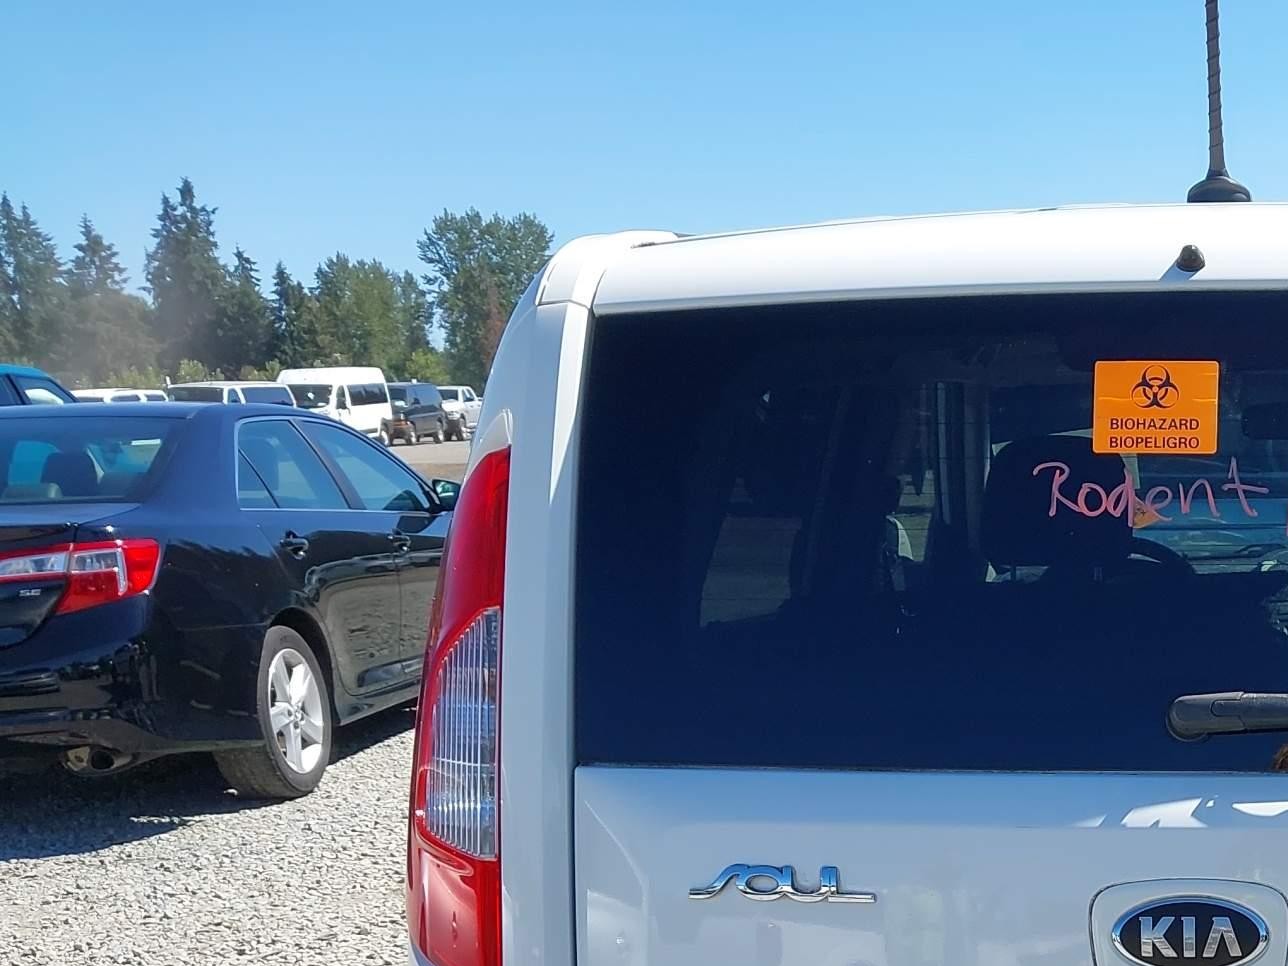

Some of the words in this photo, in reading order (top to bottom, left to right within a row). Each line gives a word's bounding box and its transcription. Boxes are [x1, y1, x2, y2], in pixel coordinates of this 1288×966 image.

[1109, 436, 1200, 449] BIOPELIGRO
[1110, 418, 1200, 430] BIOHAZARD
[1032, 456, 1269, 528] Rodent
[688, 863, 875, 903] SOUL
[1138, 915, 1243, 958] KIA
